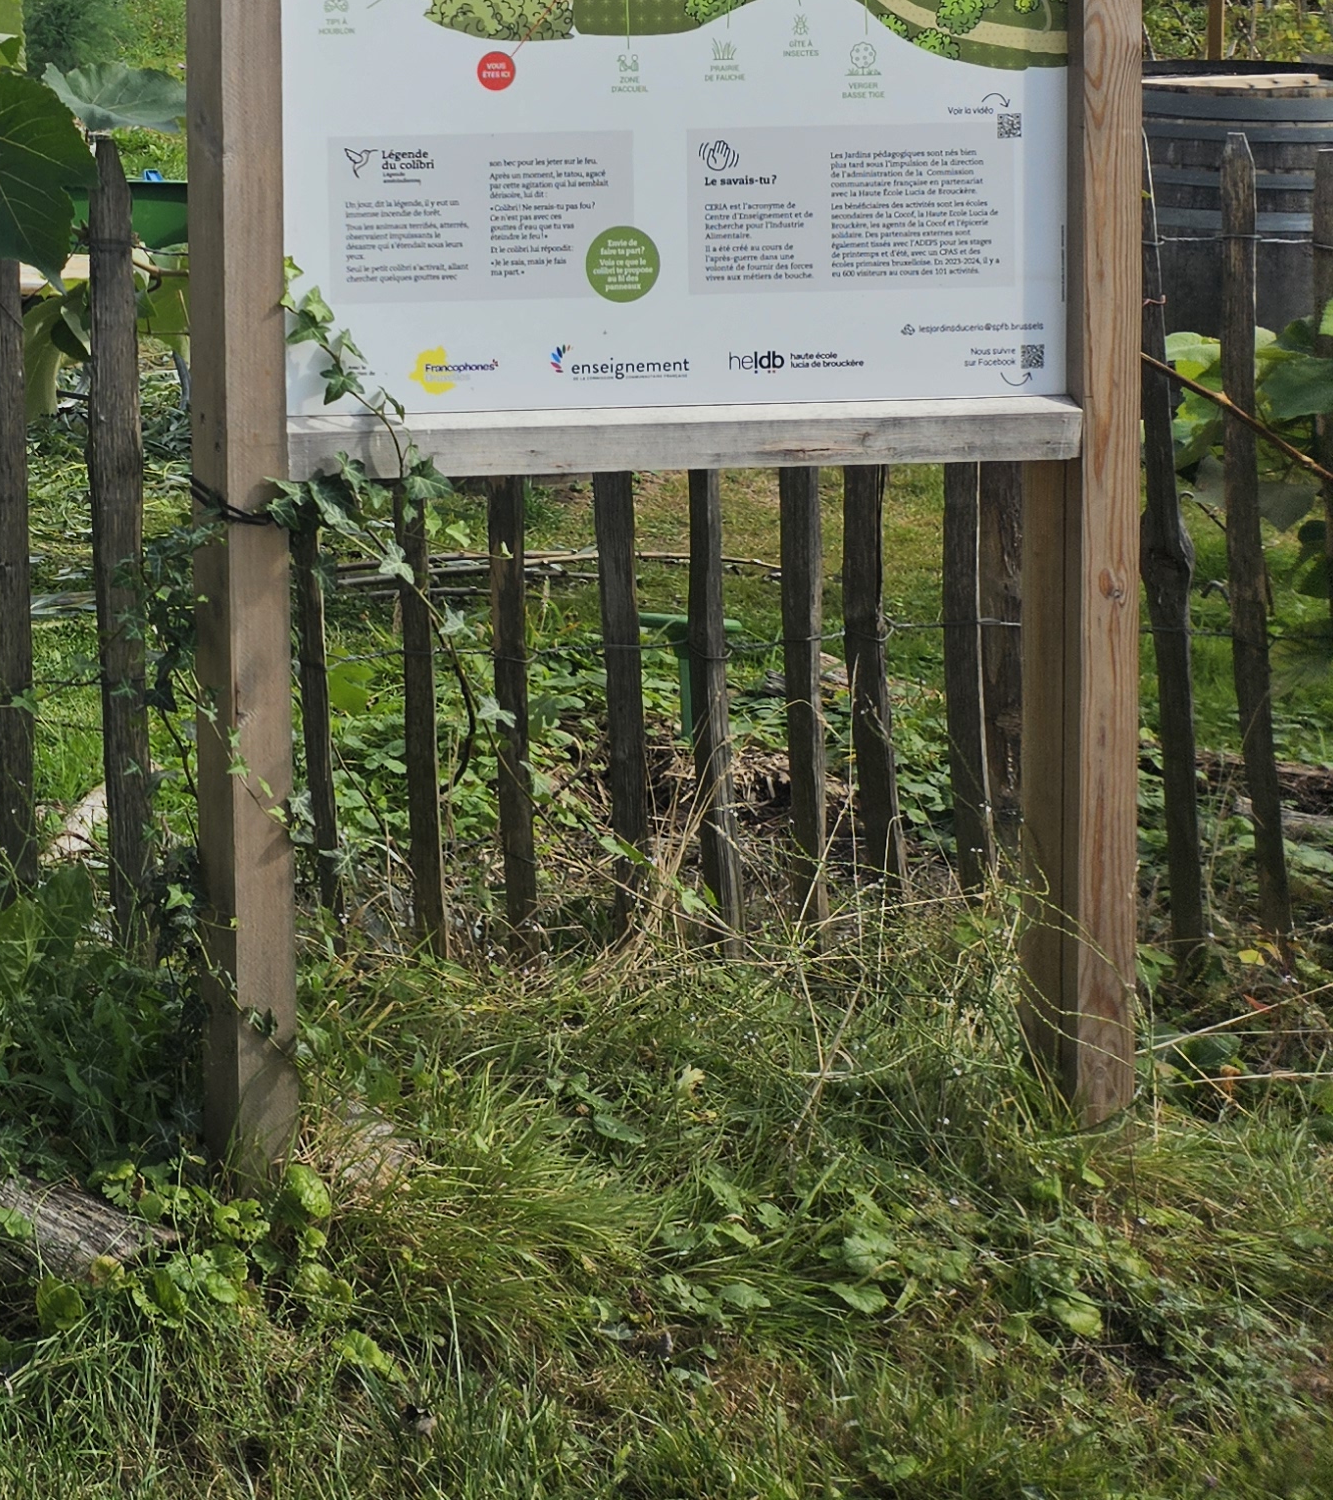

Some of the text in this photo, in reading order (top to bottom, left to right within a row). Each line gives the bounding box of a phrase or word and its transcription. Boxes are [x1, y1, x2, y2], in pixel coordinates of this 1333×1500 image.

[789, 39, 813, 48] GÎTE À
[486, 62, 506, 70] VOUS
[710, 64, 739, 72] PRAIRIE
[482, 70, 501, 78] ÊTES
[705, 74, 715, 82] DE
[619, 76, 640, 84] ZONE
[611, 85, 648, 93] D'ACCUEIL
[842, 90, 885, 99] BASSE TIGE
[948, 107, 962, 115] Voir
[973, 106, 994, 115] vidéo
[382, 149, 428, 161] Légende
[382, 160, 434, 170] du colibri
[705, 175, 777, 186] Le savais-tu?
[743, 202, 784, 211] l'acronyme
[732, 212, 792, 220] d'Enseignement
[765, 221, 804, 229] l'Industrie
[705, 232, 751, 240] Alimentaire.
[626, 246, 645, 257] part?
[919, 322, 1044, 334] lesjardinsduceria@spfb.brussels
[993, 347, 1016, 355] suivre
[729, 351, 784, 371] heldb
[791, 359, 864, 369] lucia de brouckère
[978, 358, 1016, 366] Facebook
[425, 362, 495, 374] Francophones
[571, 358, 690, 380] enseignement
